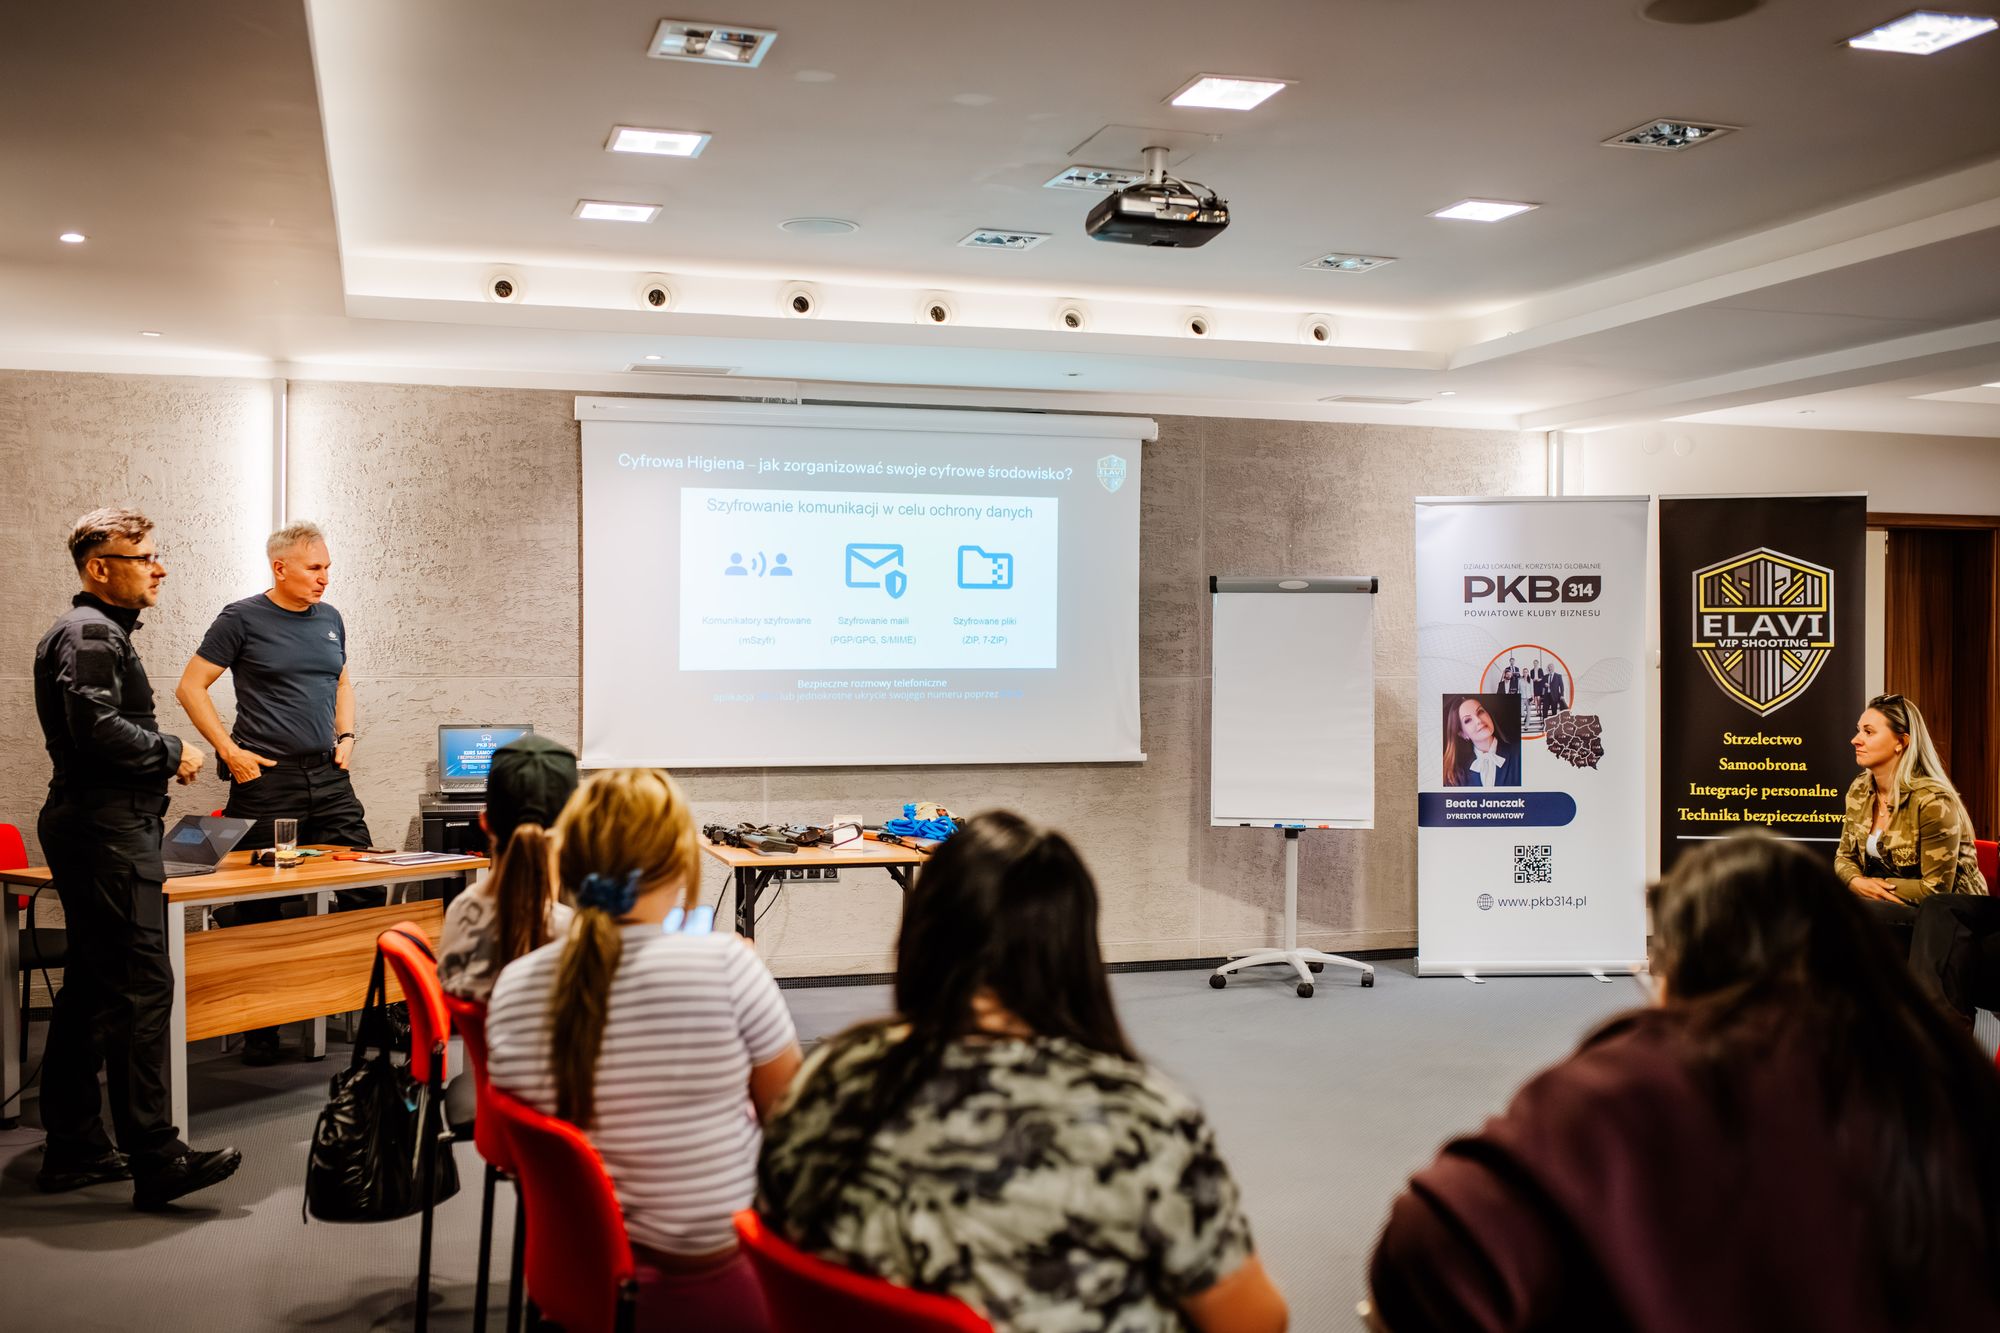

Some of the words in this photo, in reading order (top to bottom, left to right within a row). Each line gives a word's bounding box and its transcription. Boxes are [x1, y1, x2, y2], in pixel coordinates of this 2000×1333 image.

[618, 453, 683, 469] Cyfrowa
[687, 456, 744, 472] Higiena
[758, 458, 780, 474] jak
[784, 459, 883, 475] zorganizować
[886, 463, 926, 478] swoje
[929, 464, 985, 479] cyfrowe
[988, 465, 1073, 480] środowisko?
[706, 498, 793, 514] Szyfrowanie
[798, 500, 879, 518] komunikacji
[883, 504, 894, 514] w
[898, 503, 925, 516] celu
[930, 504, 982, 520] ochrony
[986, 505, 1033, 521] danych
[1464, 576, 1560, 603] PKB
[1568, 583, 1594, 597] 314
[702, 616, 761, 626] Komunikatory
[838, 616, 888, 626] Szyfrowanie
[953, 617, 999, 627] Szyfrowane
[1703, 614, 1823, 637] ELAVI
[1718, 639, 1739, 647] VIP
[1742, 638, 1809, 648] SHOOTING
[797, 679, 848, 690] Bezpieczne
[851, 680, 891, 690] rozmowy
[894, 678, 947, 688] telefoniczne
[1723, 732, 1803, 746] Strzelectwo
[1719, 758, 1807, 771] Samoobrona
[1690, 783, 1758, 799] Integracje
[1761, 784, 1838, 800] personalne
[1446, 799, 1478, 808] Beata
[1480, 798, 1526, 808] Janczak
[1482, 812, 1524, 820] POWIATOWY
[1678, 808, 1740, 821] Technika
[1498, 896, 1587, 909] www.pkb314.pl
